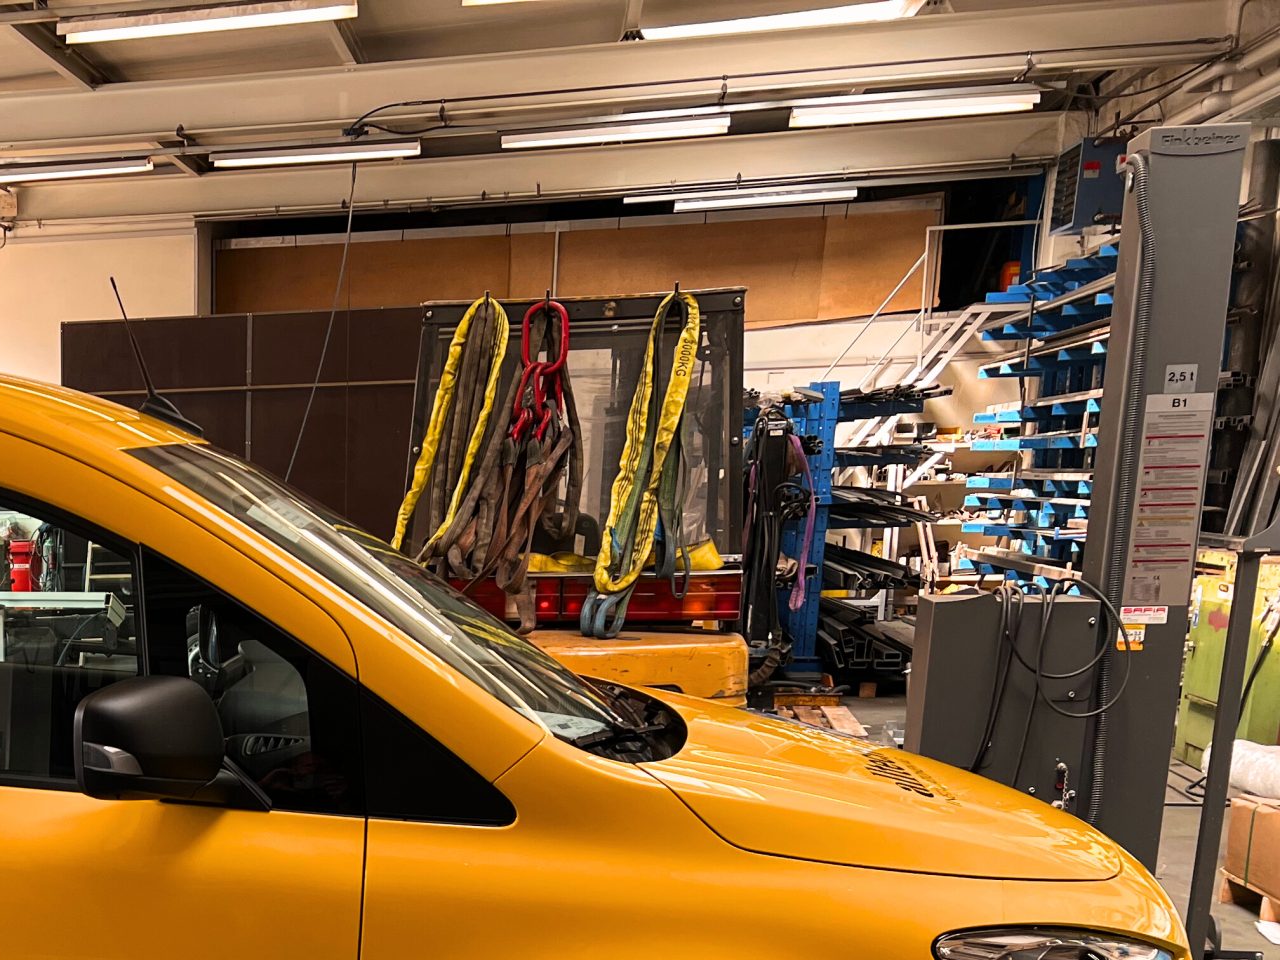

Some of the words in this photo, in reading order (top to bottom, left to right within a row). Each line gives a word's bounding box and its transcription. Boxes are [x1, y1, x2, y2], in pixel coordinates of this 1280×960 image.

[676, 338, 694, 377] 3000KG
[1167, 371, 1186, 383] 2,5
[1171, 398, 1188, 408] B1
